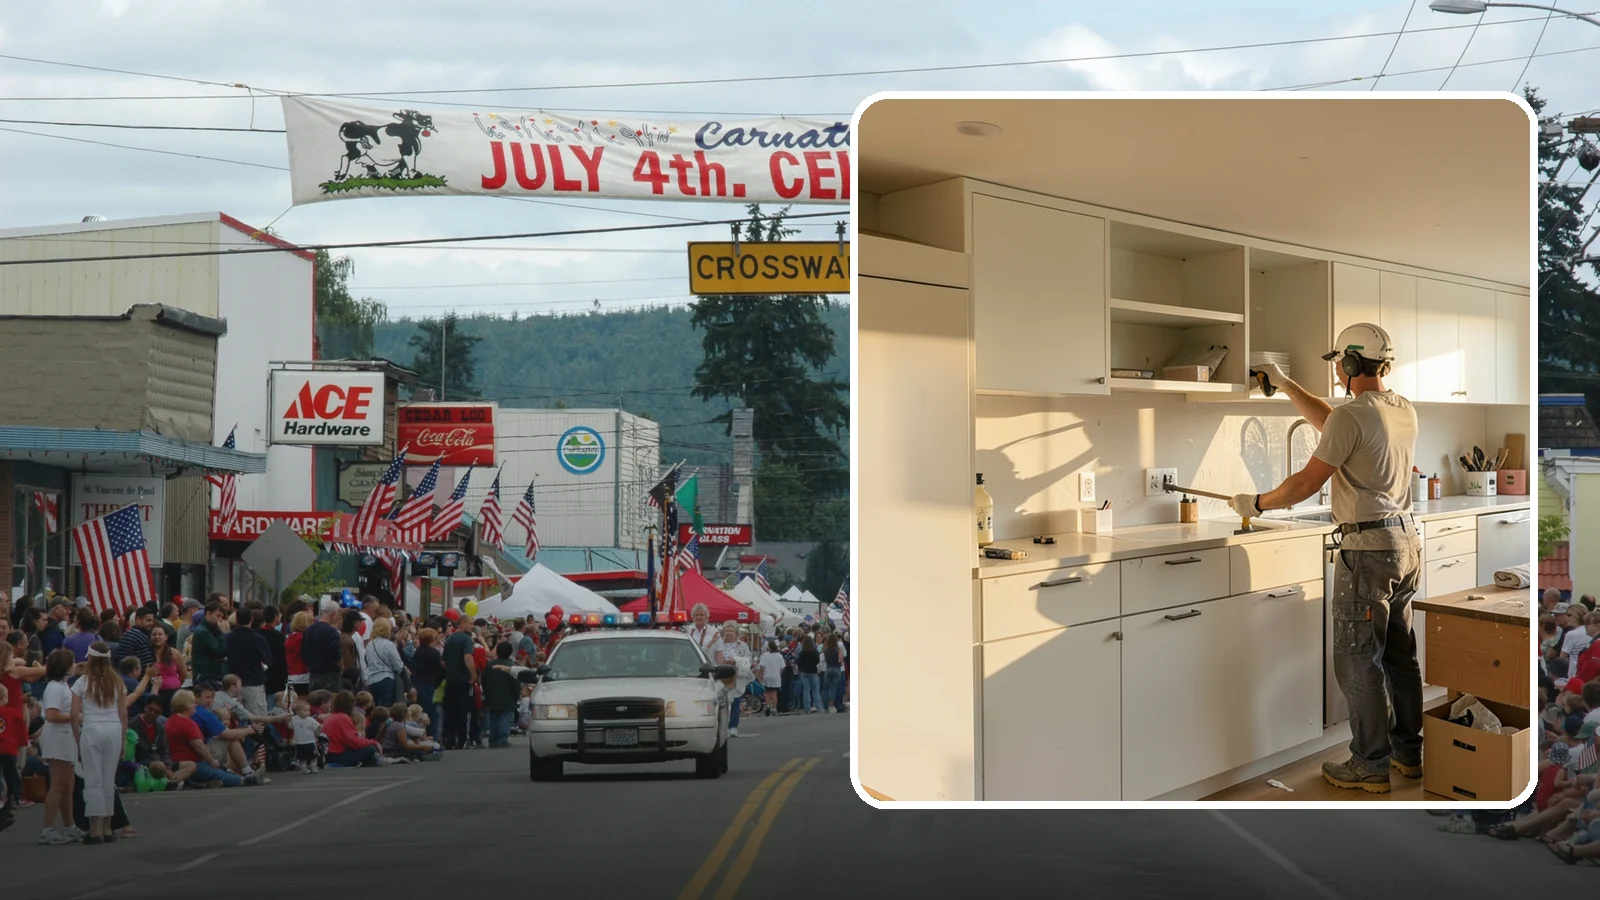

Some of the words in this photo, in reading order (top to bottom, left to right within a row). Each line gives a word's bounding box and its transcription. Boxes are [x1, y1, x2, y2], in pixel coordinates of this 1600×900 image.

[481, 140, 604, 193] JULY
[632, 149, 746, 198] 4th.
[697, 254, 850, 280] CROSSWA
[283, 380, 373, 420] ACE
[405, 409, 453, 422] CEDAR
[283, 421, 371, 437] Hardware
[416, 428, 477, 447] Coca-Cola
[94, 485, 124, 495] Vincent
[126, 485, 136, 495] de
[137, 485, 155, 495] Paul
[688, 526, 742, 535] CRNATION
[699, 535, 730, 544] GLASS
